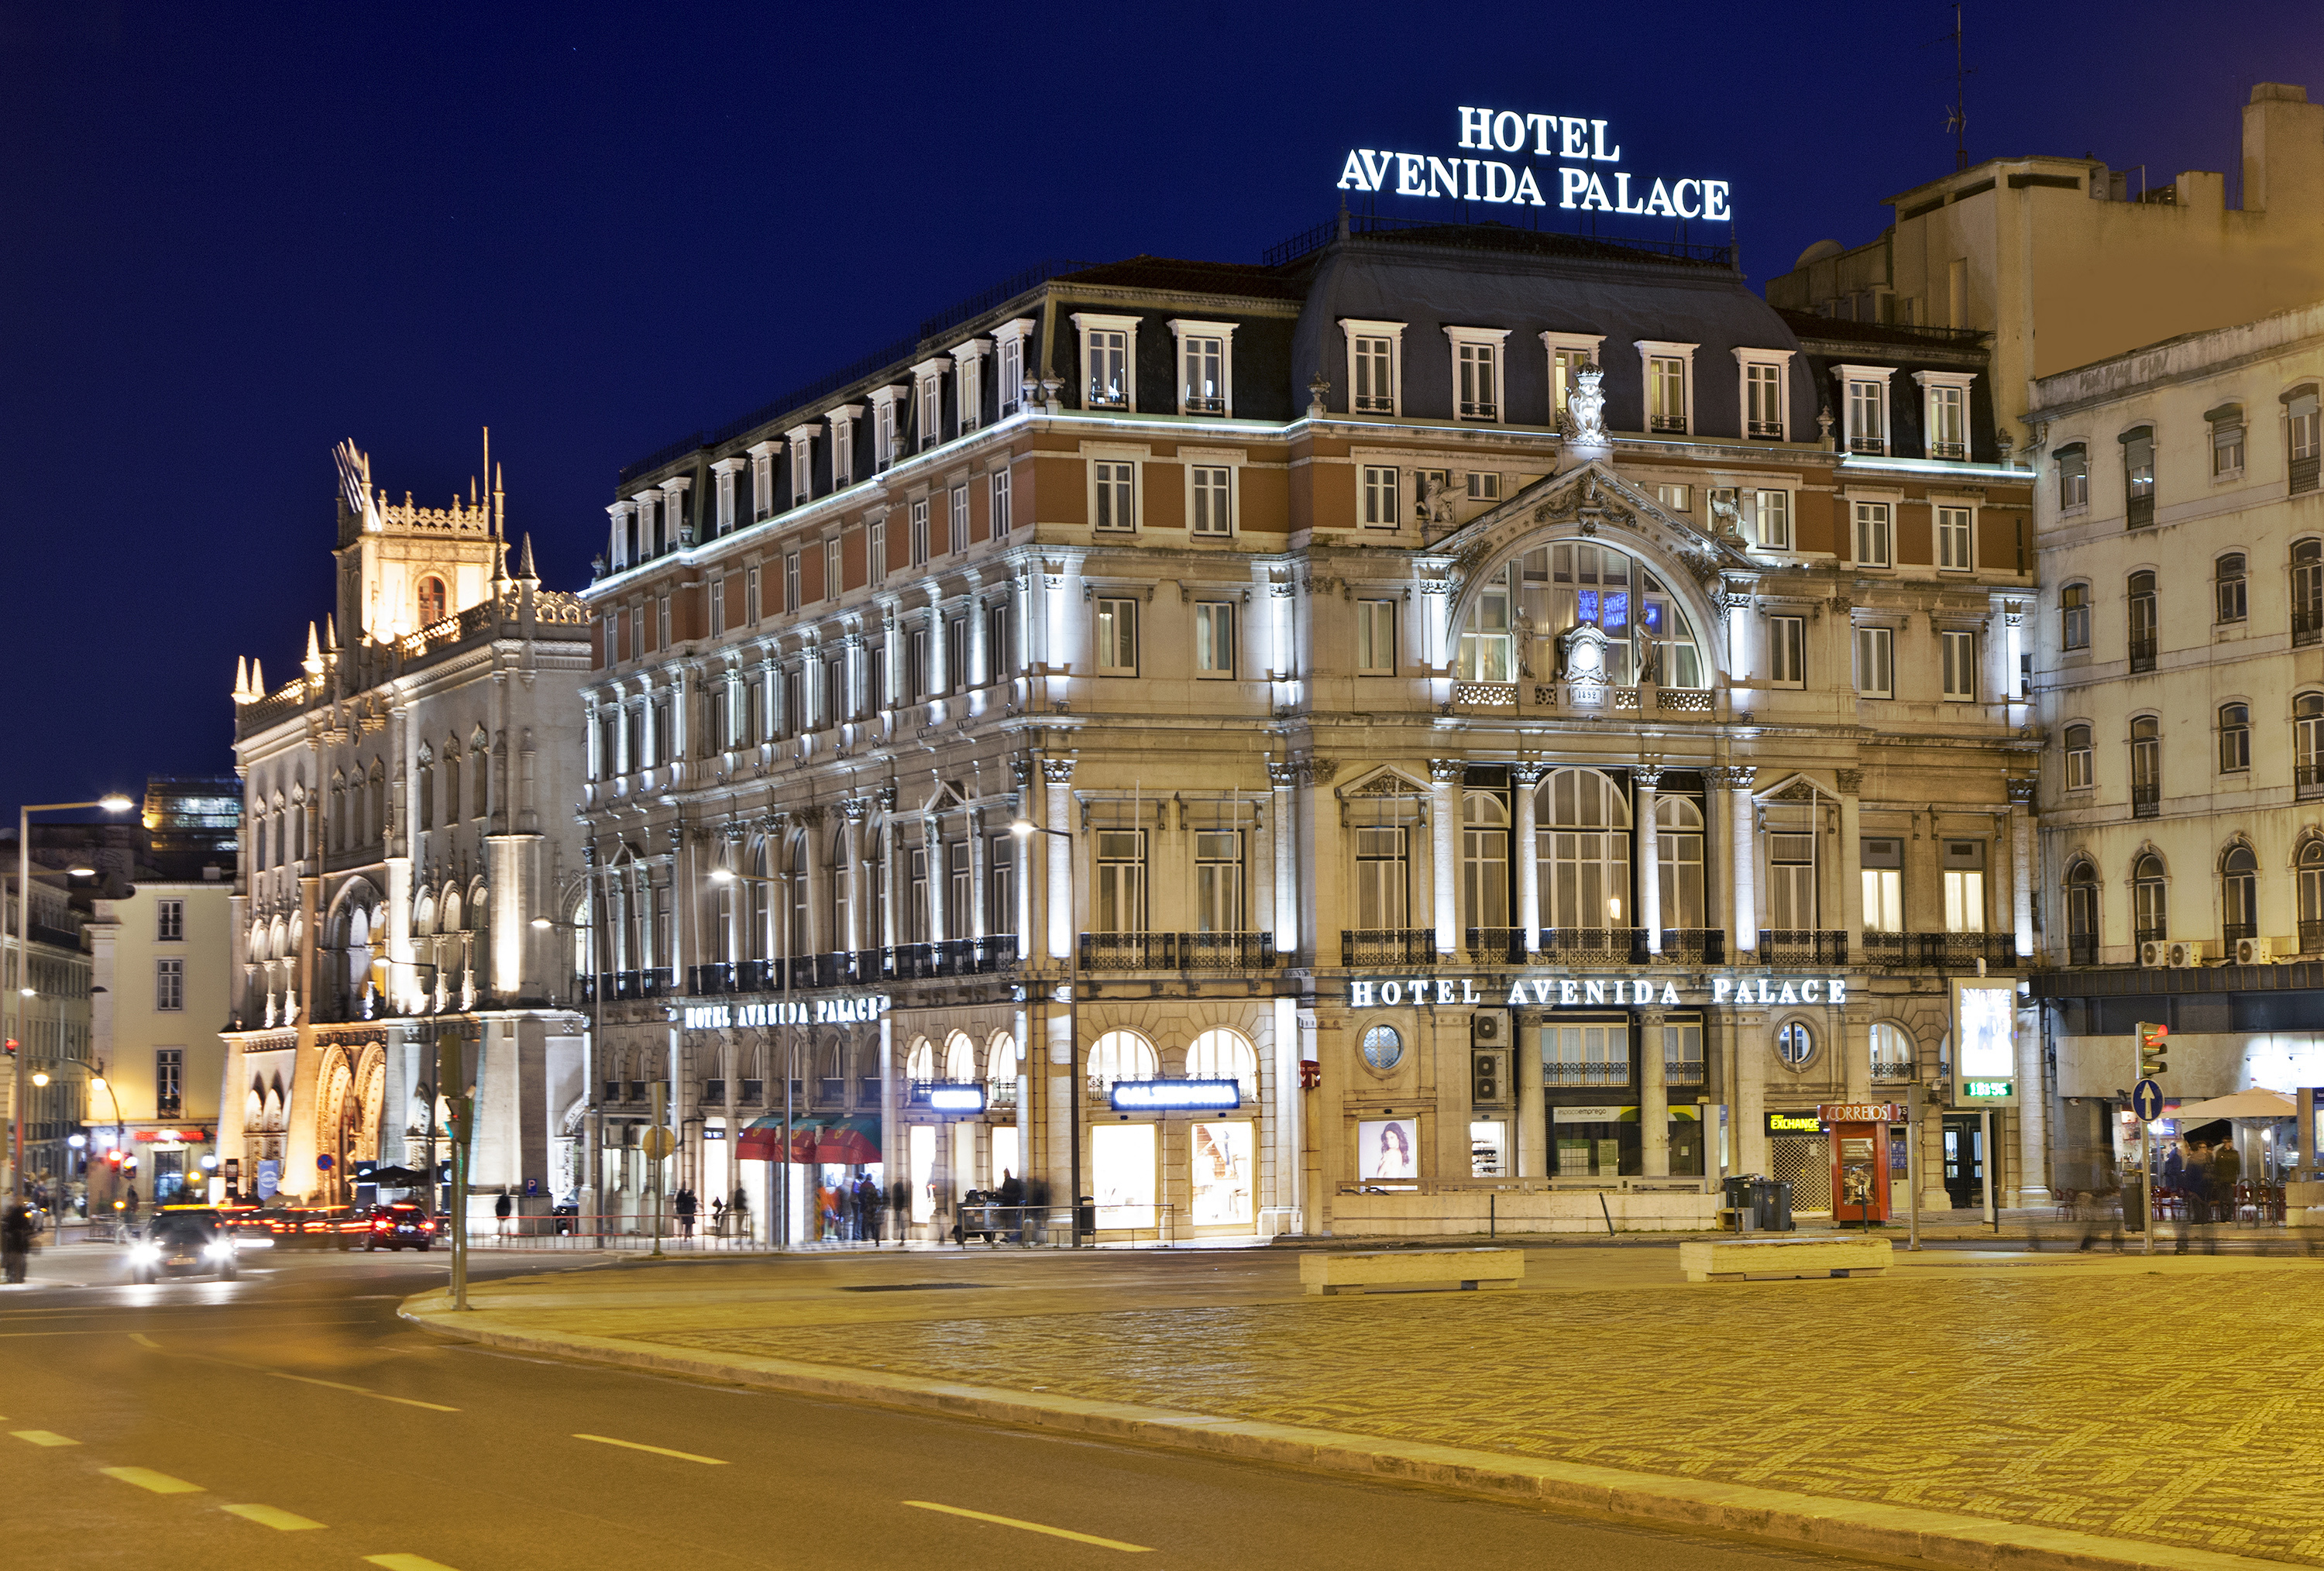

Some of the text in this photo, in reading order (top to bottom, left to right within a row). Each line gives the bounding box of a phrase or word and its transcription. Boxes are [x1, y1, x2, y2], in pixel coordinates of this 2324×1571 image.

[1457, 105, 1620, 162] HOTEL
[1336, 148, 1731, 221] AVENIDA PALACE
[1578, 690, 1597, 699] 1892
[1350, 978, 1846, 1006] HOTEL AVENIDA PALACE
[685, 997, 878, 1029] HOTEL AVENIDA PALACE
[1828, 1105, 1888, 1120] CORREIOS
[1771, 1119, 1819, 1129] EXCHANGE
[528, 1179, 535, 1189] P
